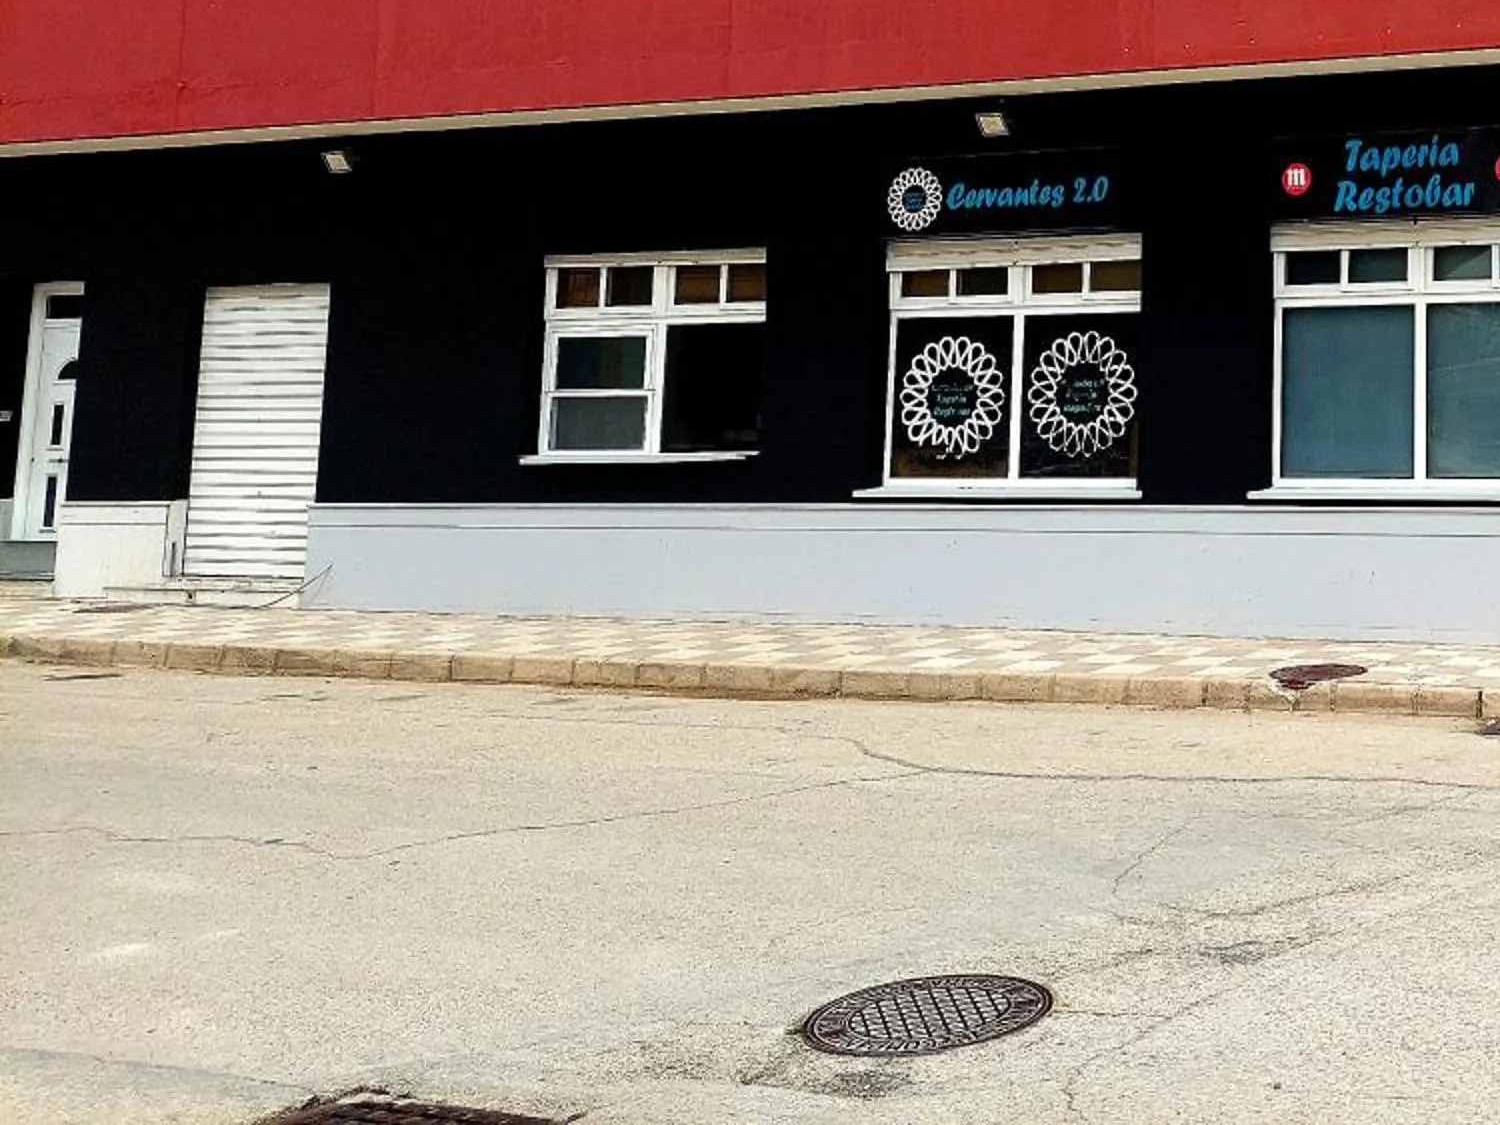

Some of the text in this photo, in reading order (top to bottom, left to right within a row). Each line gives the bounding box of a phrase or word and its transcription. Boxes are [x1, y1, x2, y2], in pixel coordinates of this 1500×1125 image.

[1345, 135, 1459, 177] Taperia
[946, 179, 1065, 210] Cervantes
[1072, 176, 1109, 203] 2.0
[1334, 174, 1475, 214] Restobar
